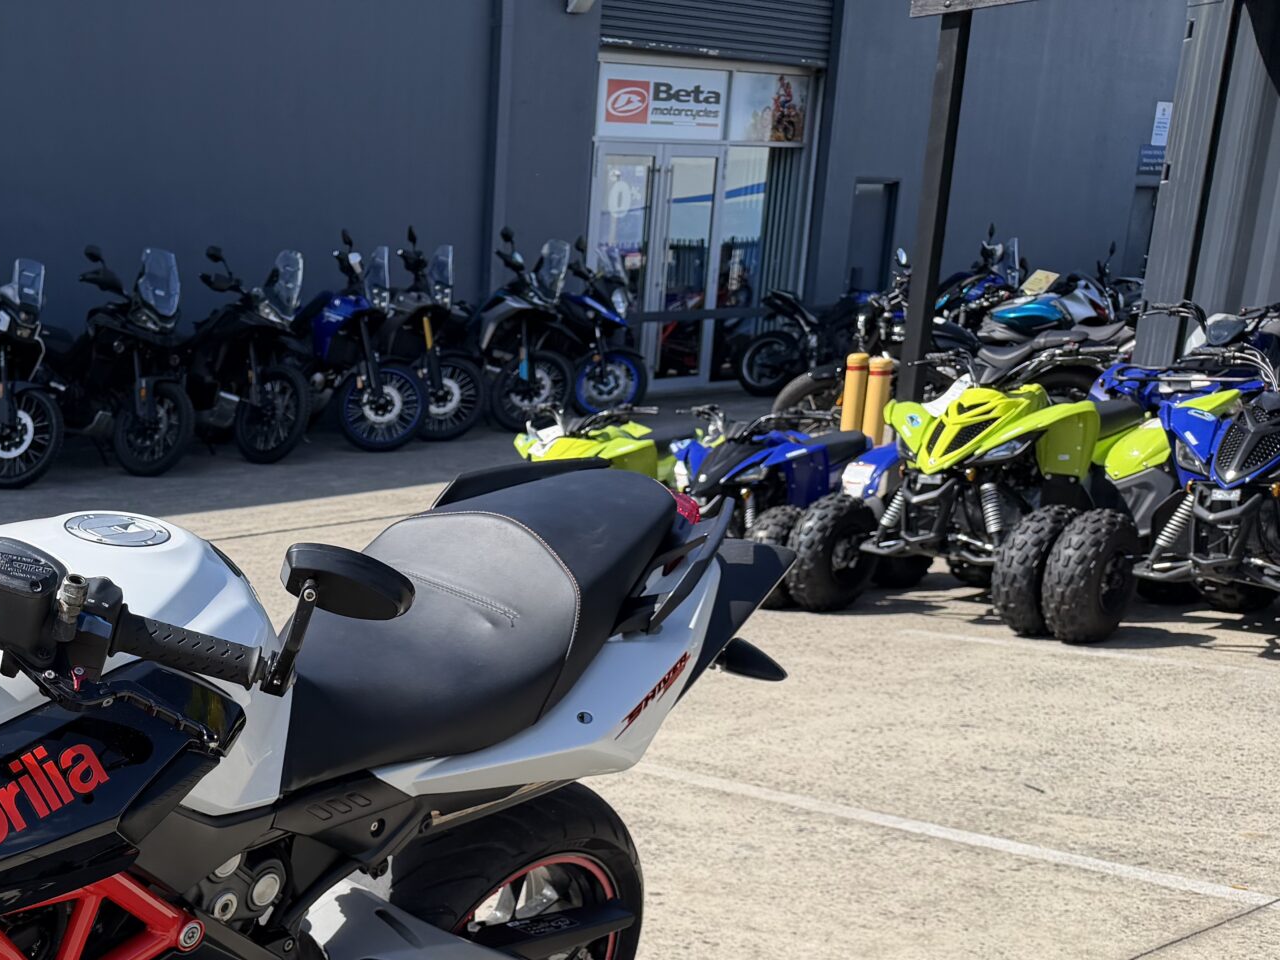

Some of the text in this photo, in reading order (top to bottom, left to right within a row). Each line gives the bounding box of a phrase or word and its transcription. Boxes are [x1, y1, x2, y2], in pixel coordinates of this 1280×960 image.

[653, 81, 721, 105] Beta
[651, 105, 719, 120] motorcycles
[615, 651, 692, 740] SHIVER
